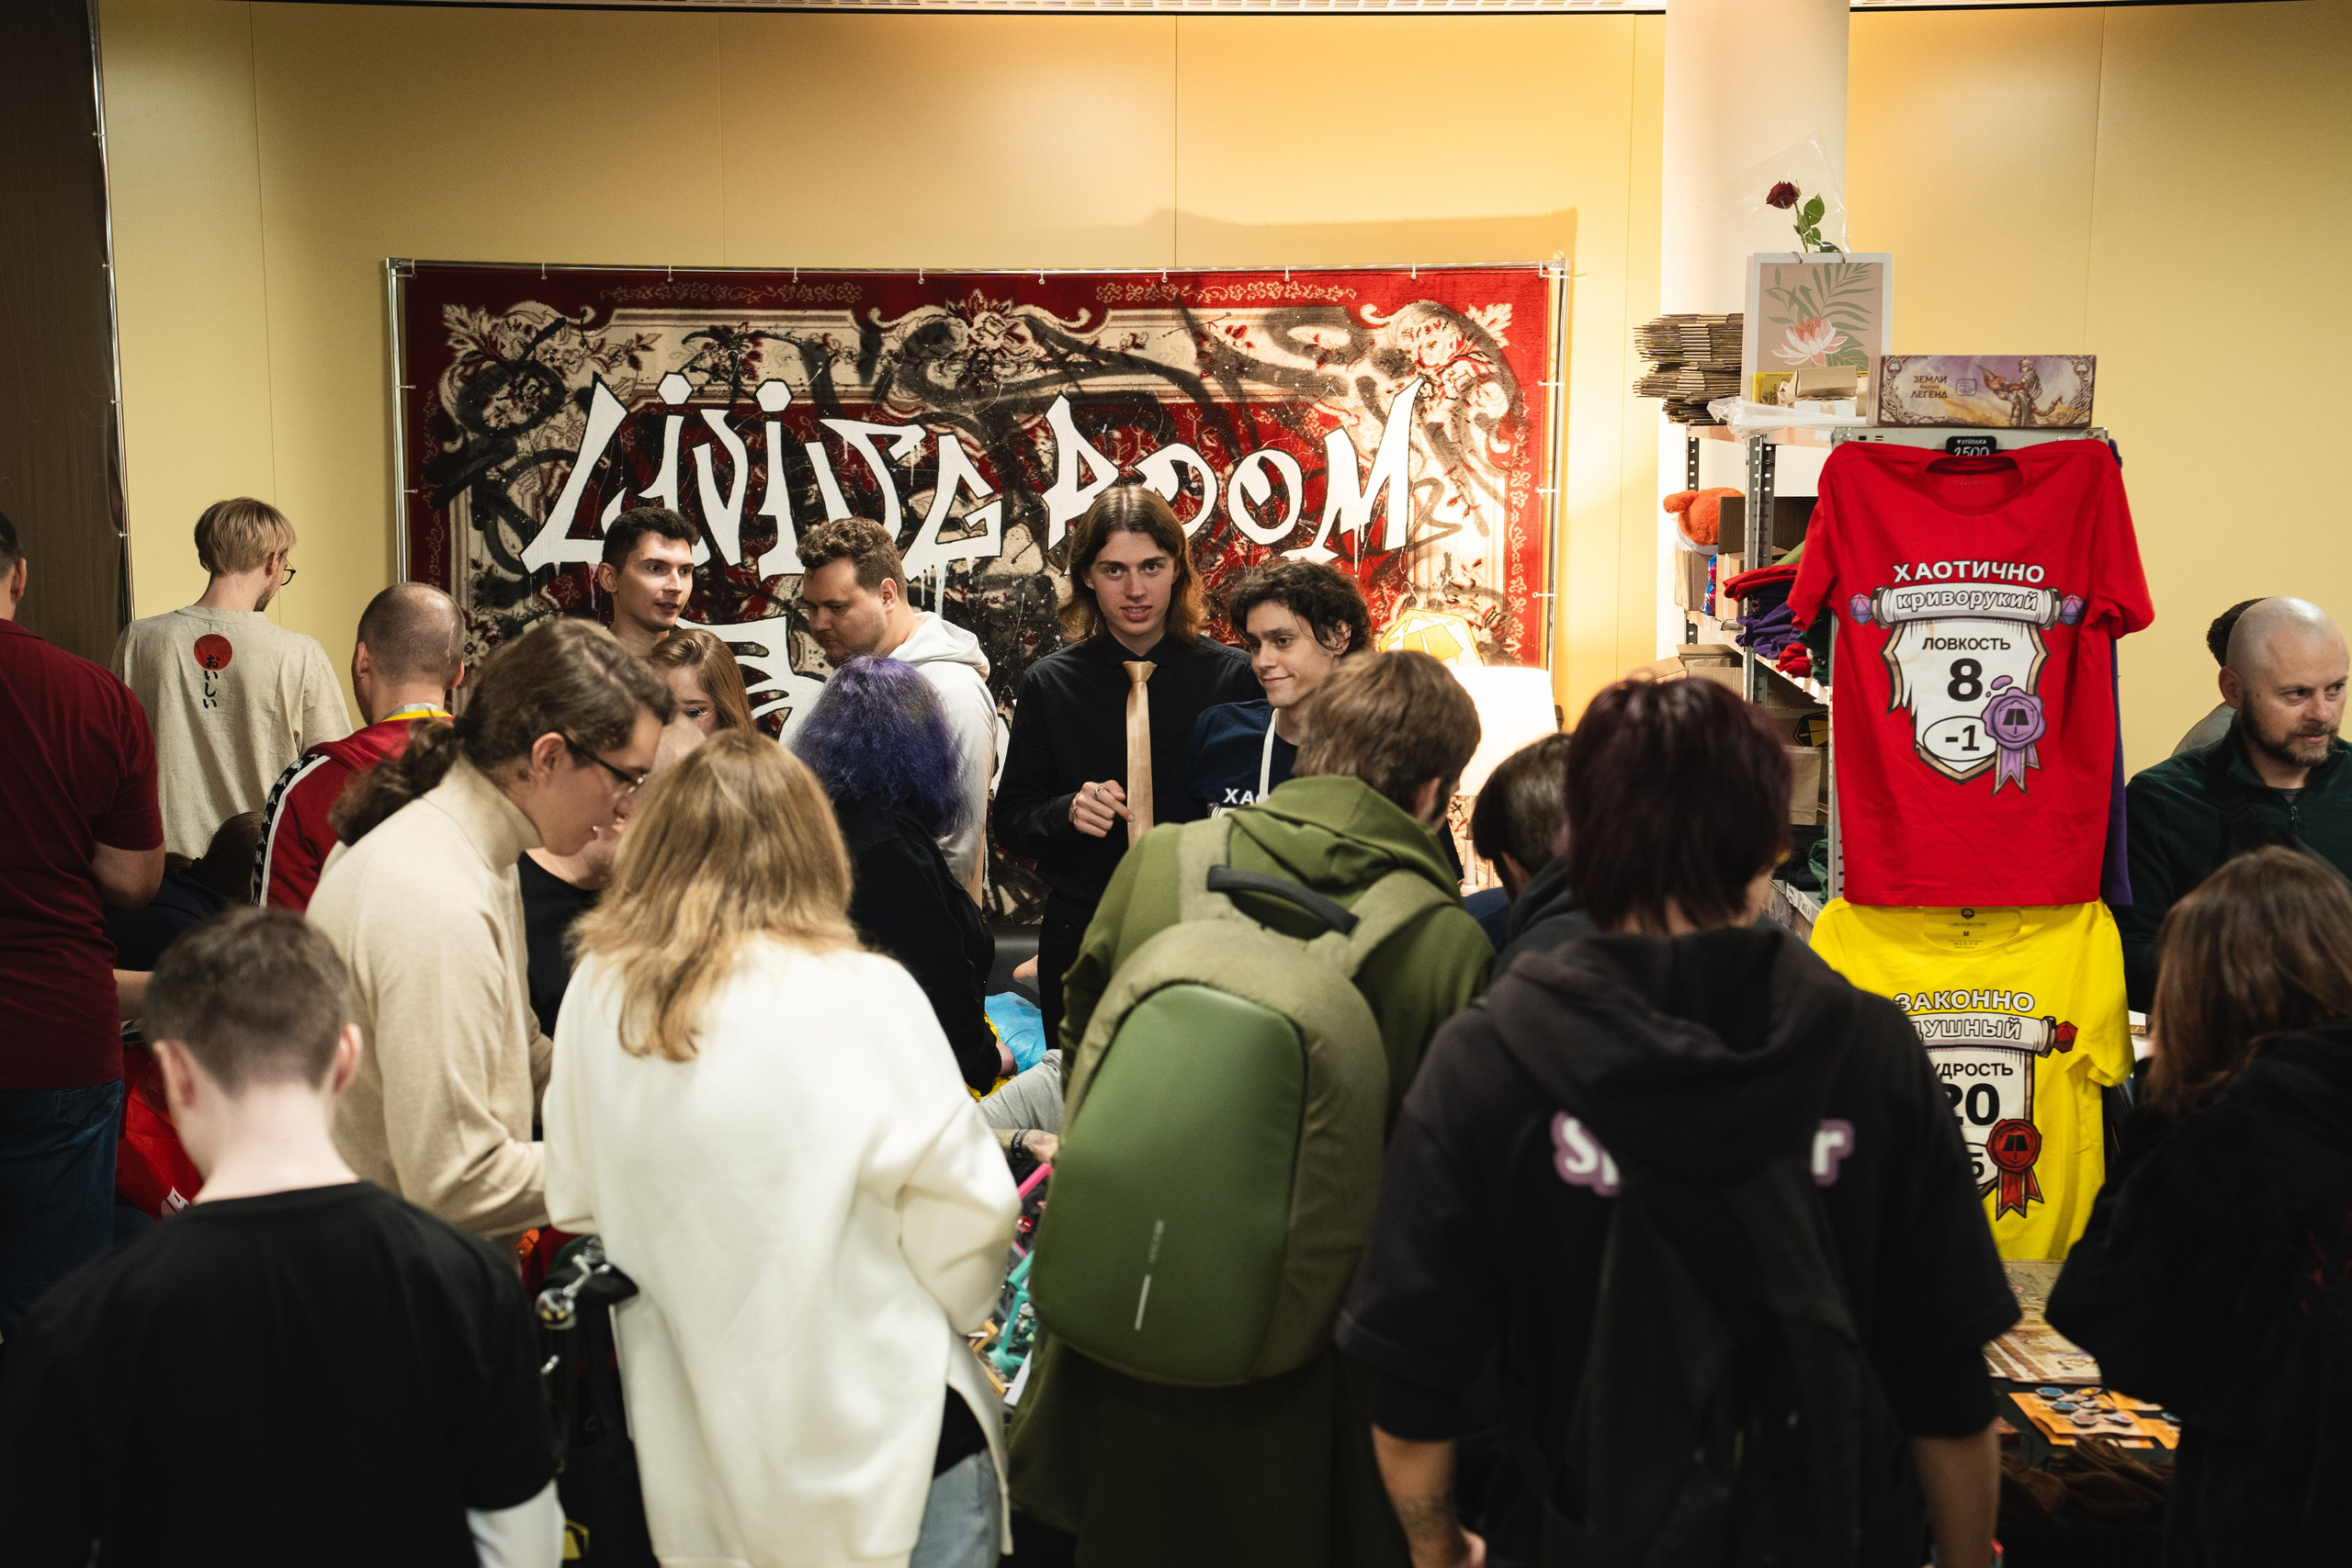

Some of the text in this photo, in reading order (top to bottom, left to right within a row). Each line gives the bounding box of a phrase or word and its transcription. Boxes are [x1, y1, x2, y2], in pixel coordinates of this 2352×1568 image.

[1913, 375, 1948, 384] ЗЕМЛИ
[1910, 390, 1949, 399] ЛЕГЕНД
[1893, 559, 2045, 583] ХАОТИЧНО
[1895, 589, 2040, 612] криворукий
[1921, 637, 2011, 651] ЛОВКОСТЬ
[203, 653, 221, 709] おいしい
[1947, 658, 1983, 702] 8
[1945, 724, 1981, 751] -1
[1894, 989, 2035, 1012] ЗАКОННО
[1945, 1083, 2000, 1126] 20
